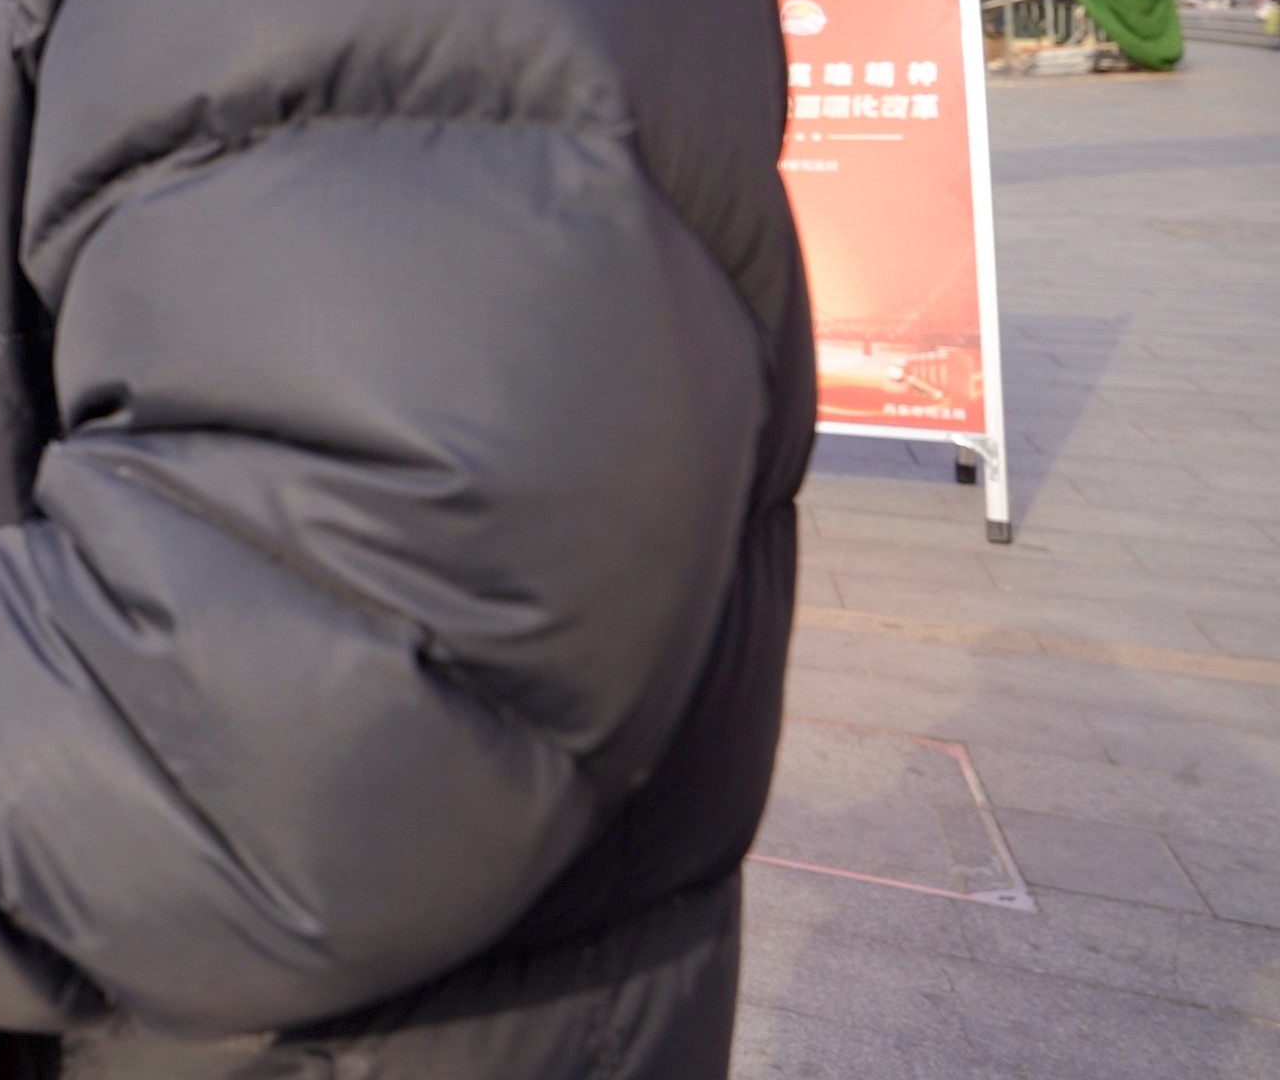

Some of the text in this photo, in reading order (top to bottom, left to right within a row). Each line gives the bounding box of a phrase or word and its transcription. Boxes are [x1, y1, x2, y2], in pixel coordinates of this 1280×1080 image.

[787, 93, 939, 120] 面深化改革
